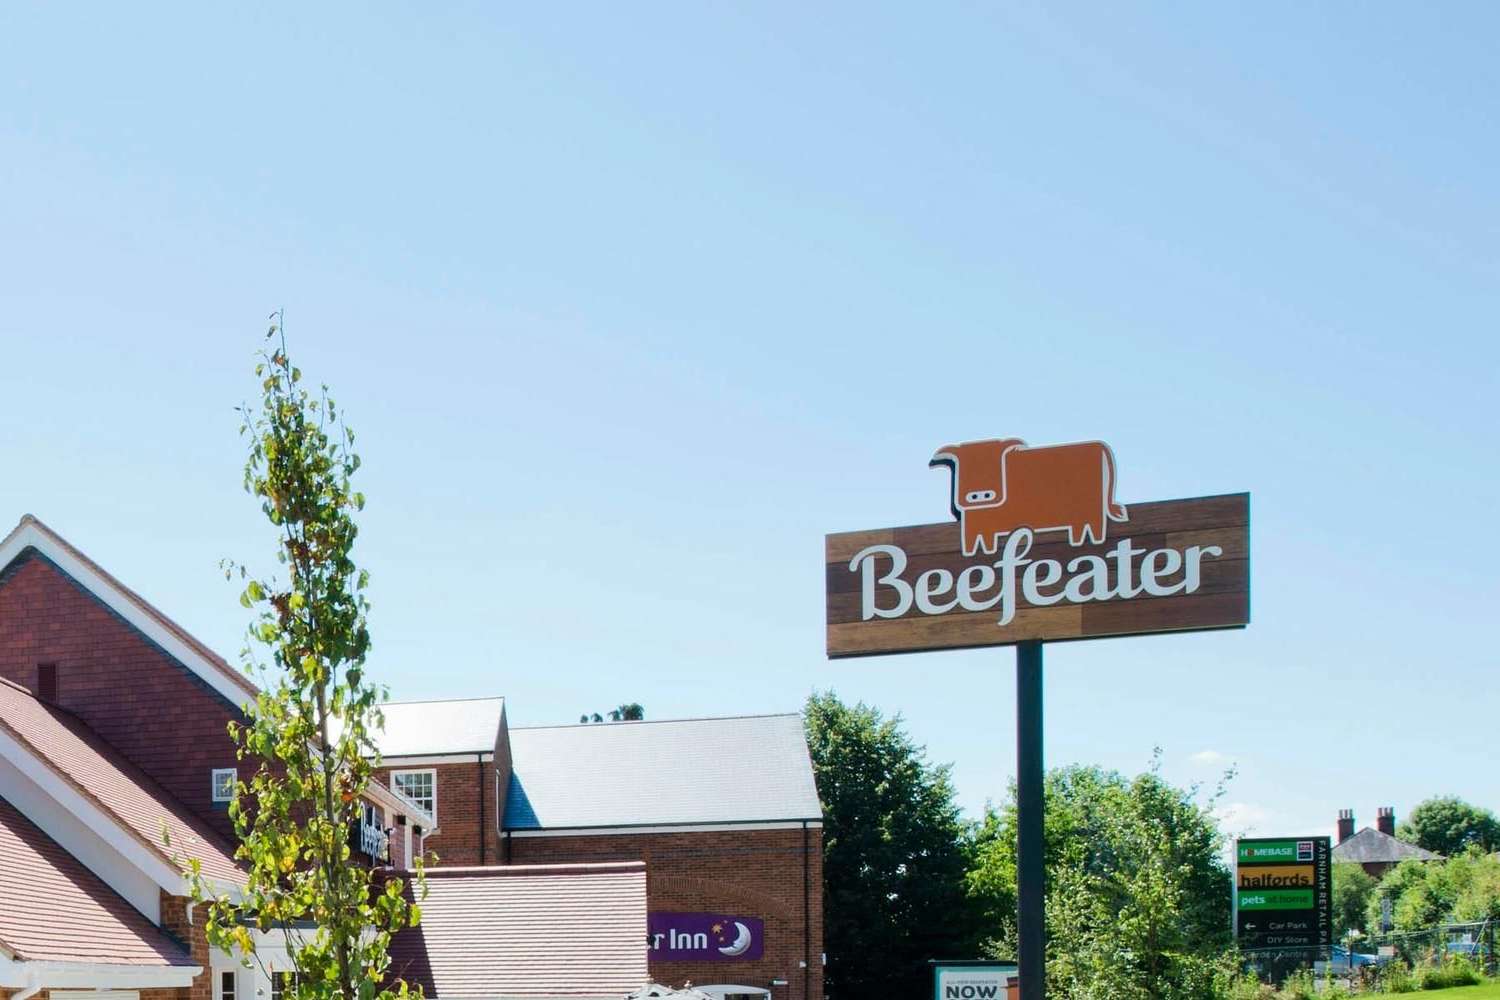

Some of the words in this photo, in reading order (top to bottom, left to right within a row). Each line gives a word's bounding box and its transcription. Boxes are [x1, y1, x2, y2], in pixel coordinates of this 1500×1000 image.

[848, 527, 1224, 626] Beefeater
[1240, 847, 1294, 857] HOMEBASE
[1318, 840, 1327, 889] FARNHAM
[1240, 873, 1310, 888] halfords
[1241, 895, 1266, 906] pets
[1318, 892, 1327, 928] RETAIL
[1268, 922, 1284, 930] Car
[669, 928, 708, 949] Inn
[1267, 936, 1282, 944] DIY
[946, 985, 998, 999] NOW
